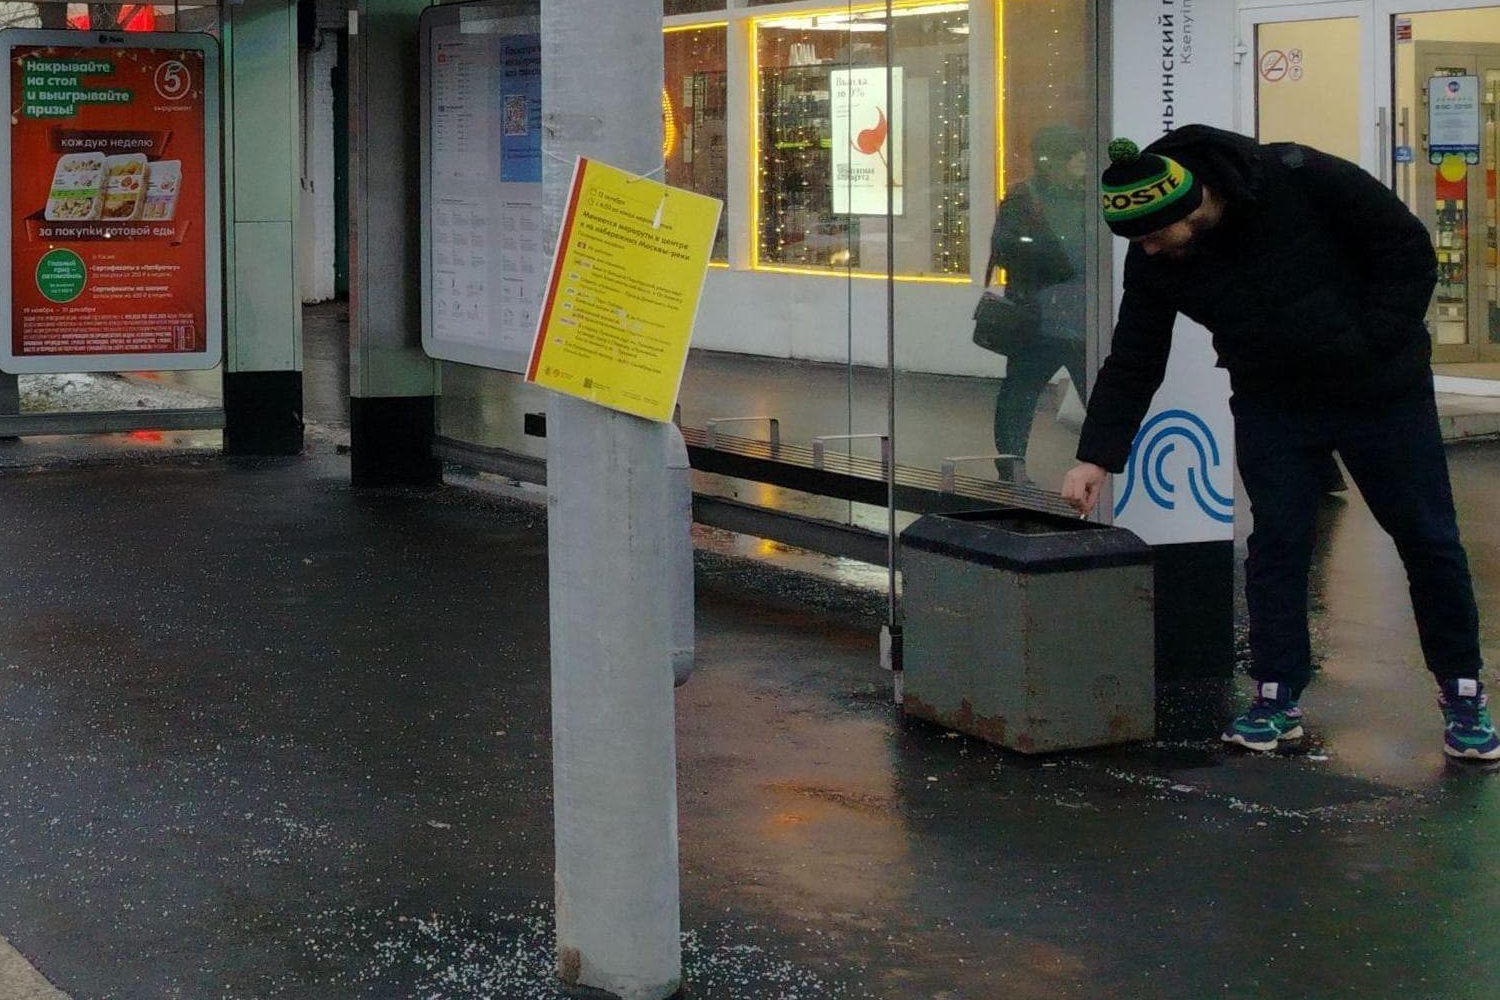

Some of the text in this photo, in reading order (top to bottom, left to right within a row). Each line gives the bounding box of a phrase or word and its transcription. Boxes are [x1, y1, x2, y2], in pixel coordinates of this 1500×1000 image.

[27, 61, 110, 74] Накрывайте
[1157, 13, 1175, 136] ньинский
[27, 77, 77, 86] на стол
[27, 90, 130, 102] и выигрывайте
[27, 105, 74, 118] призы!
[61, 138, 154, 149] каждую неделю
[38, 225, 175, 238] за покупки готовой еды
